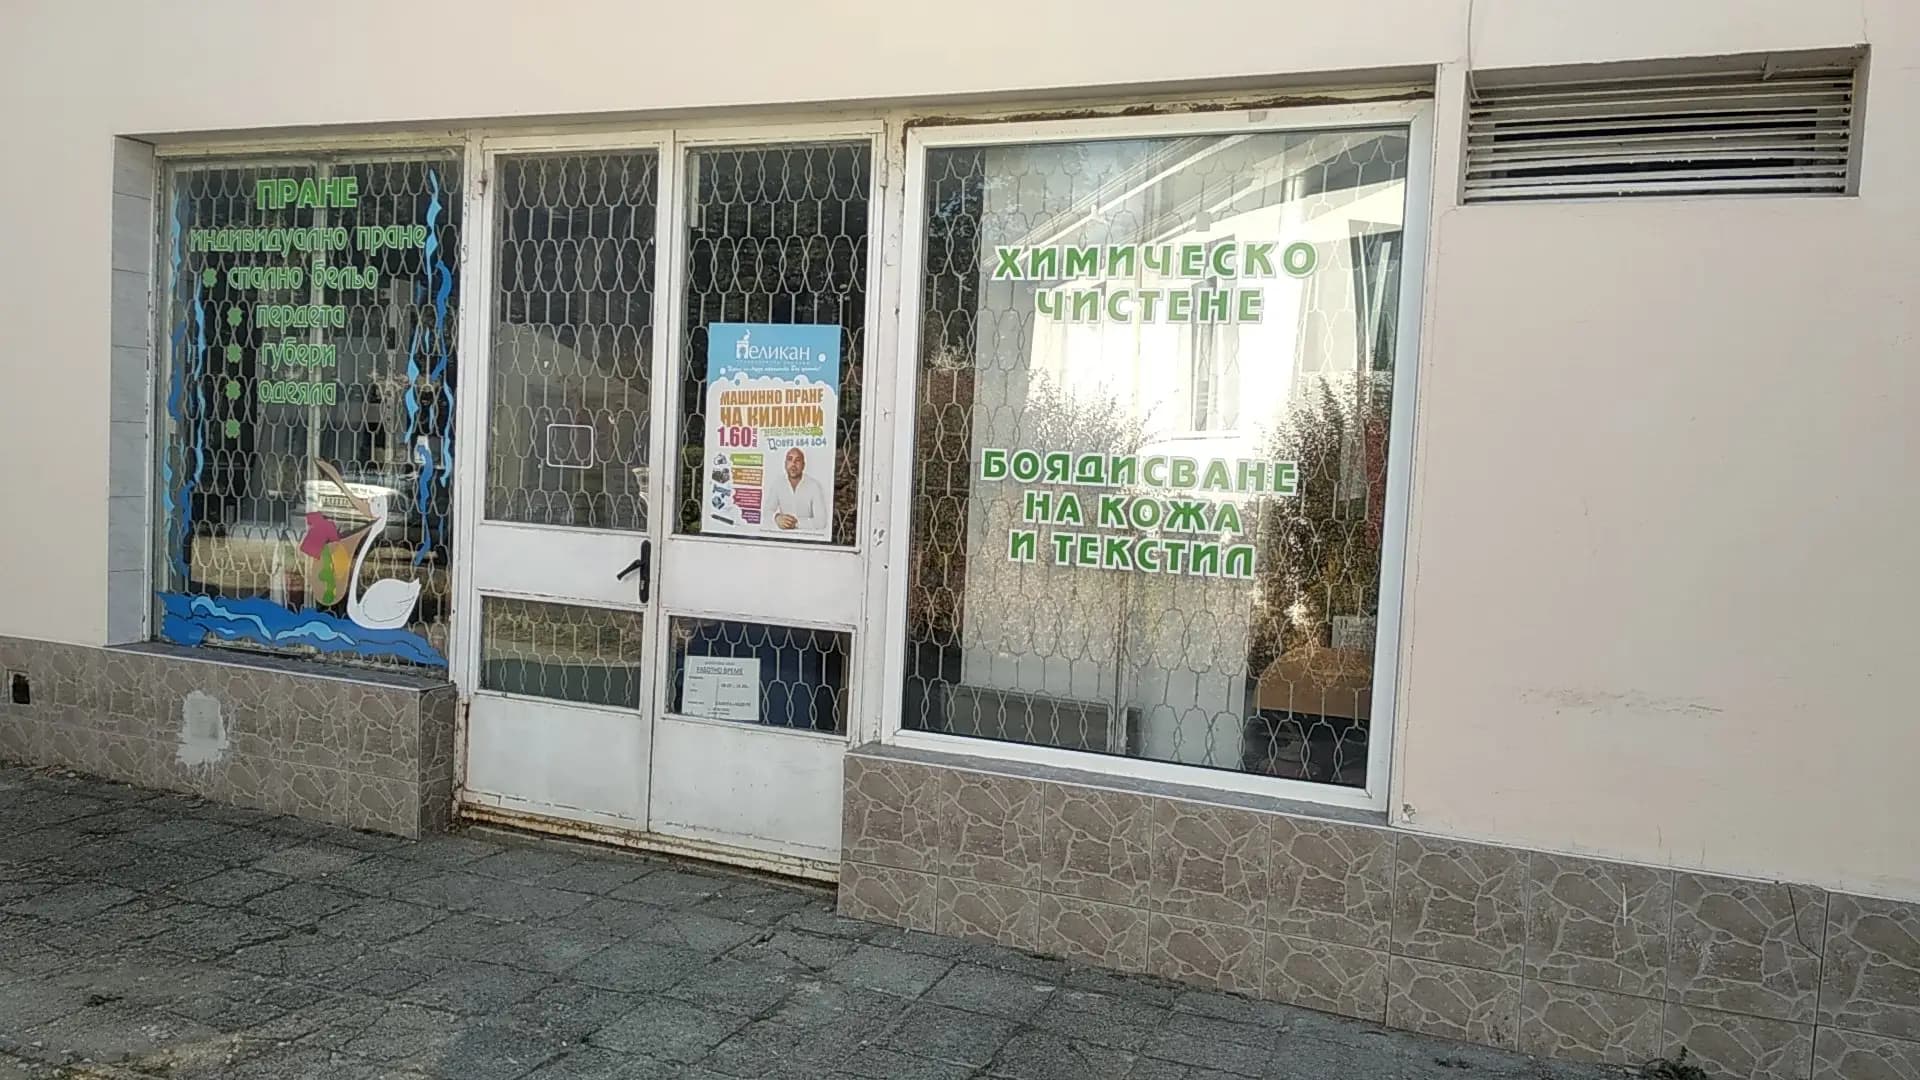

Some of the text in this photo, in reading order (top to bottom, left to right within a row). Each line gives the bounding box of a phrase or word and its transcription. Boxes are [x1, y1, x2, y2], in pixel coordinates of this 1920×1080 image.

[256, 176, 358, 209] ПРАНЕ
[190, 225, 427, 257] индивидуално пране
[228, 259, 379, 290] спално бельо
[993, 241, 1318, 280] ХИМИЧЕСКО
[256, 305, 345, 334] пердета
[1035, 289, 1264, 323] ЧИСТЕНЕ
[261, 337, 336, 372] губери
[735, 338, 811, 361] Пеликан
[259, 380, 337, 405] одеяла
[720, 388, 824, 405] МАШИННО ПРАНЕ
[747, 406, 824, 427] КИЛИМИ
[717, 426, 752, 447] 1.60
[981, 449, 1298, 495] БОЯДИСВАНЕ
[1024, 490, 1243, 536] НА КОЖА
[1009, 530, 1255, 578] И ТЕКСТИЛ
